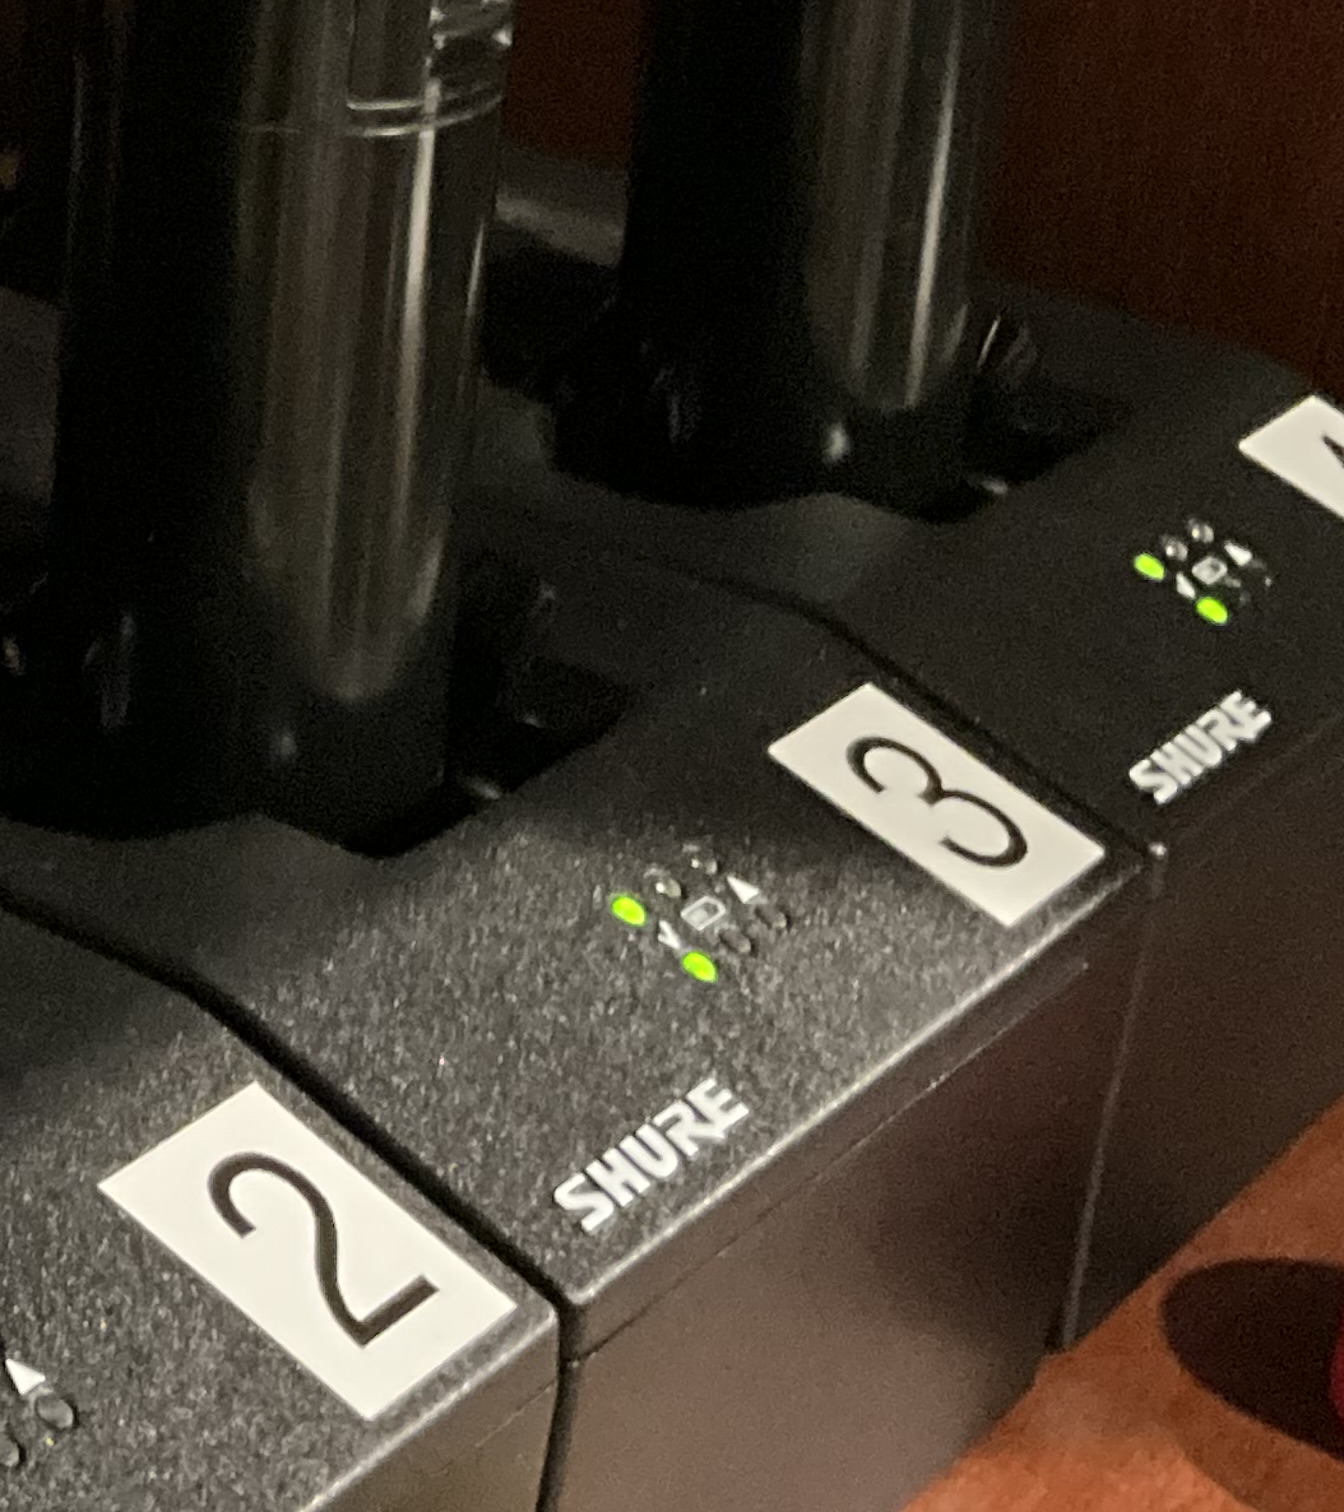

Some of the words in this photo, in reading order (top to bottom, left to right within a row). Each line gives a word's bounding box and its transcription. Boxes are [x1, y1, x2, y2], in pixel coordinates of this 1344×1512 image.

[845, 735, 1029, 868] 3
[1128, 689, 1273, 805] SHURE
[553, 1077, 750, 1232] SHURE
[207, 1150, 440, 1347] 2
